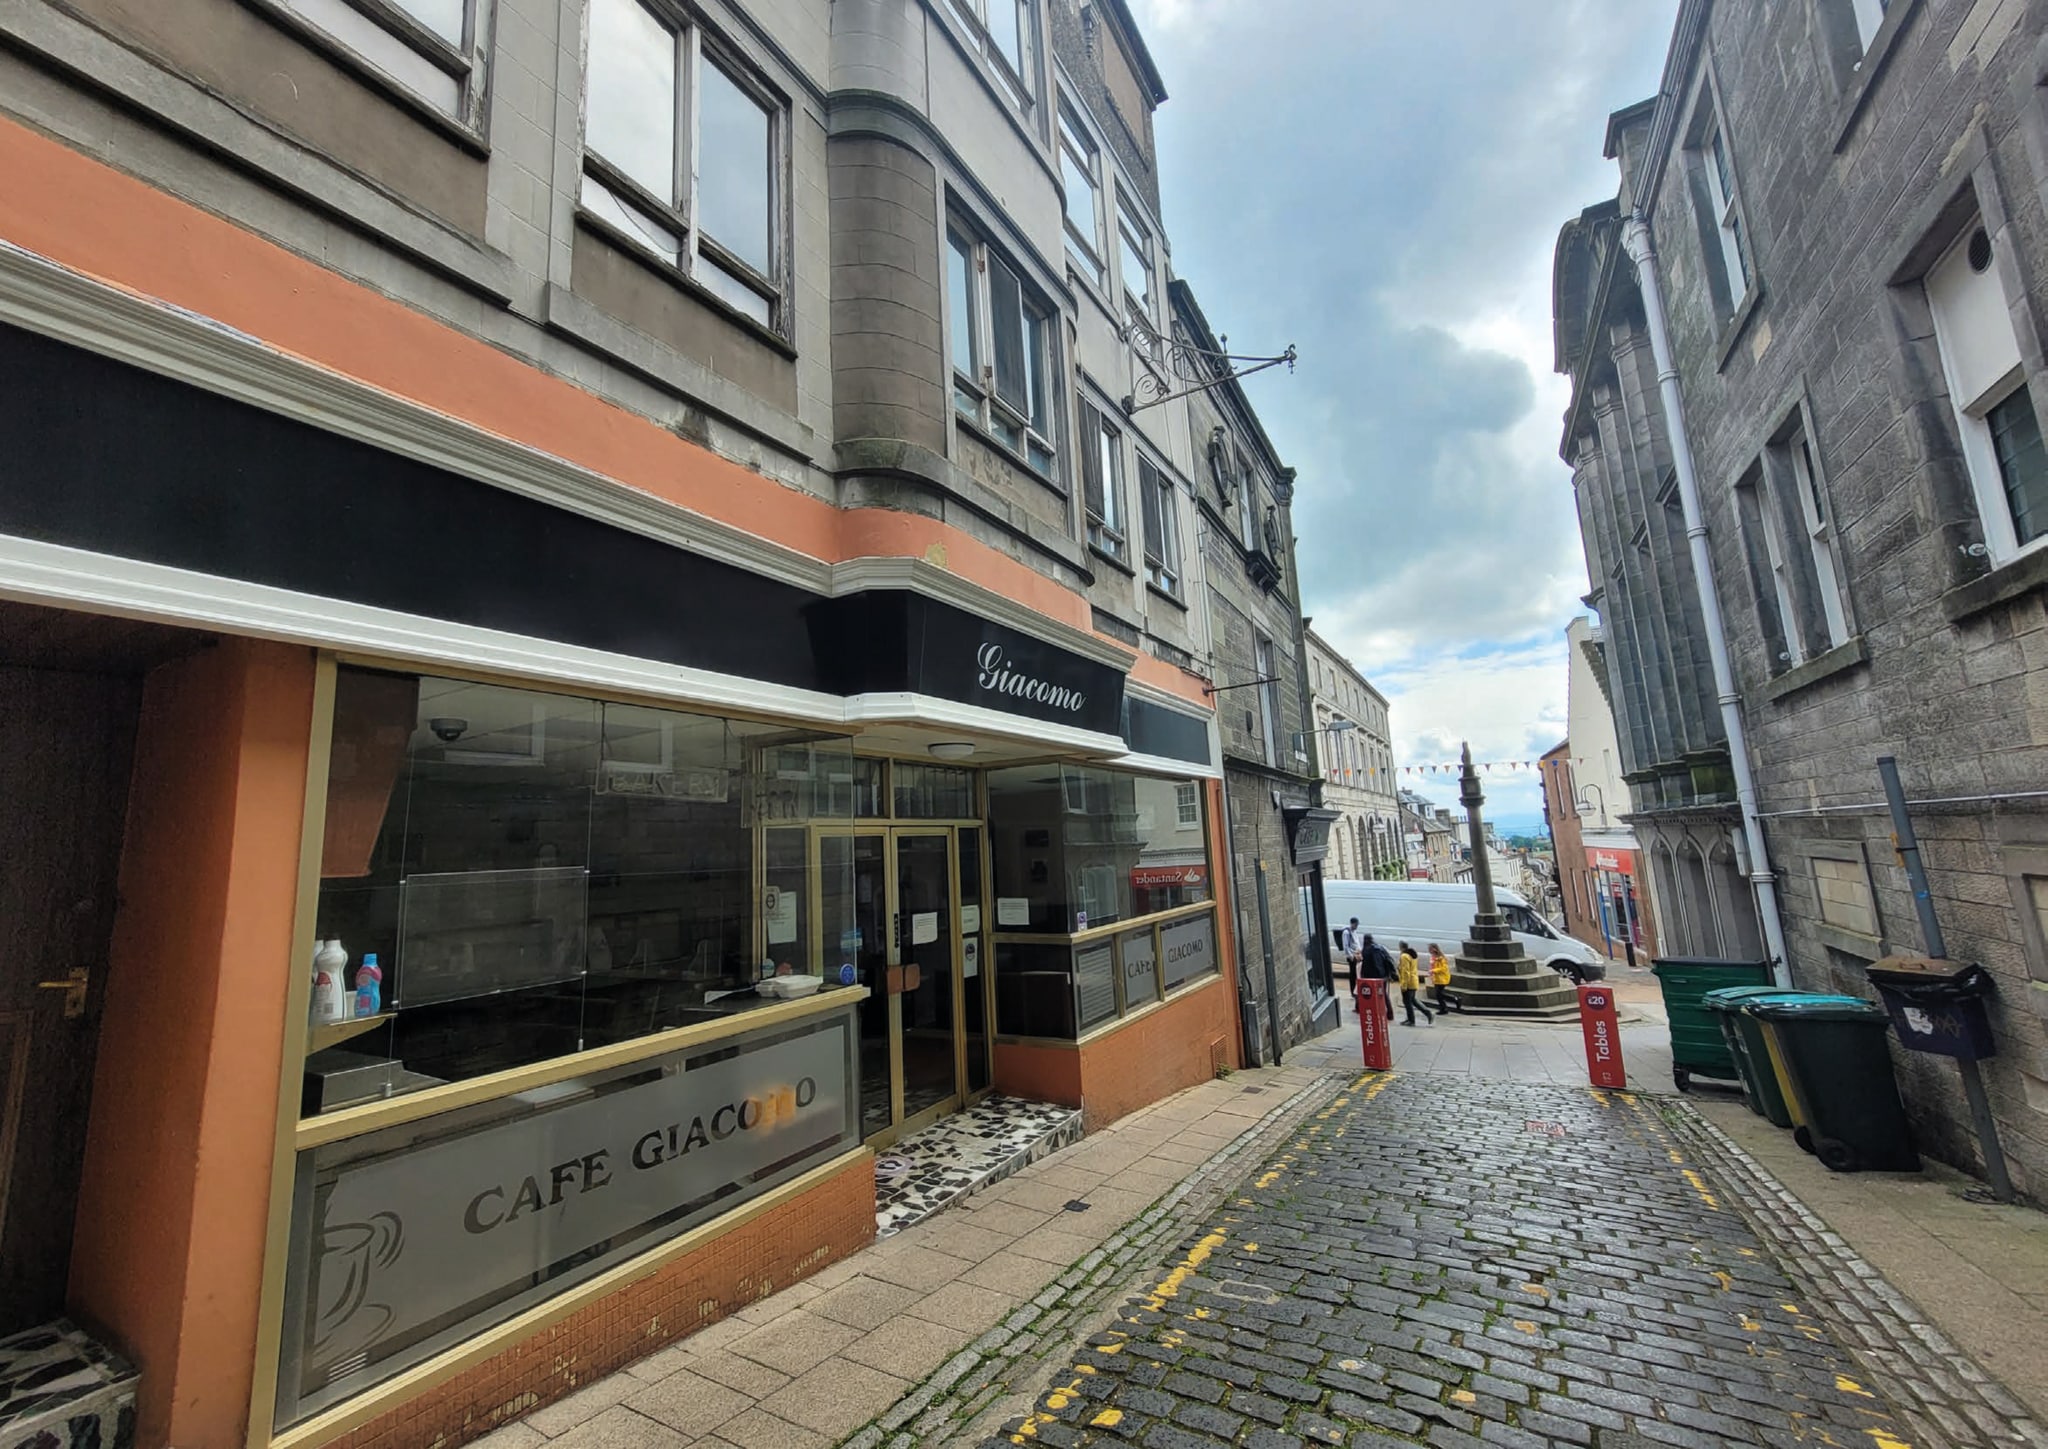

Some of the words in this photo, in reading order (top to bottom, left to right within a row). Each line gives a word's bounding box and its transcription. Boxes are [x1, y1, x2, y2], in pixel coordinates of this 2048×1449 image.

[977, 642, 1086, 711] Giacomo
[1167, 939, 1203, 963] GIACOMO
[1365, 1009, 1375, 1046] Tables
[1593, 1020, 1610, 1062] Tables
[463, 1149, 613, 1234] CAFE
